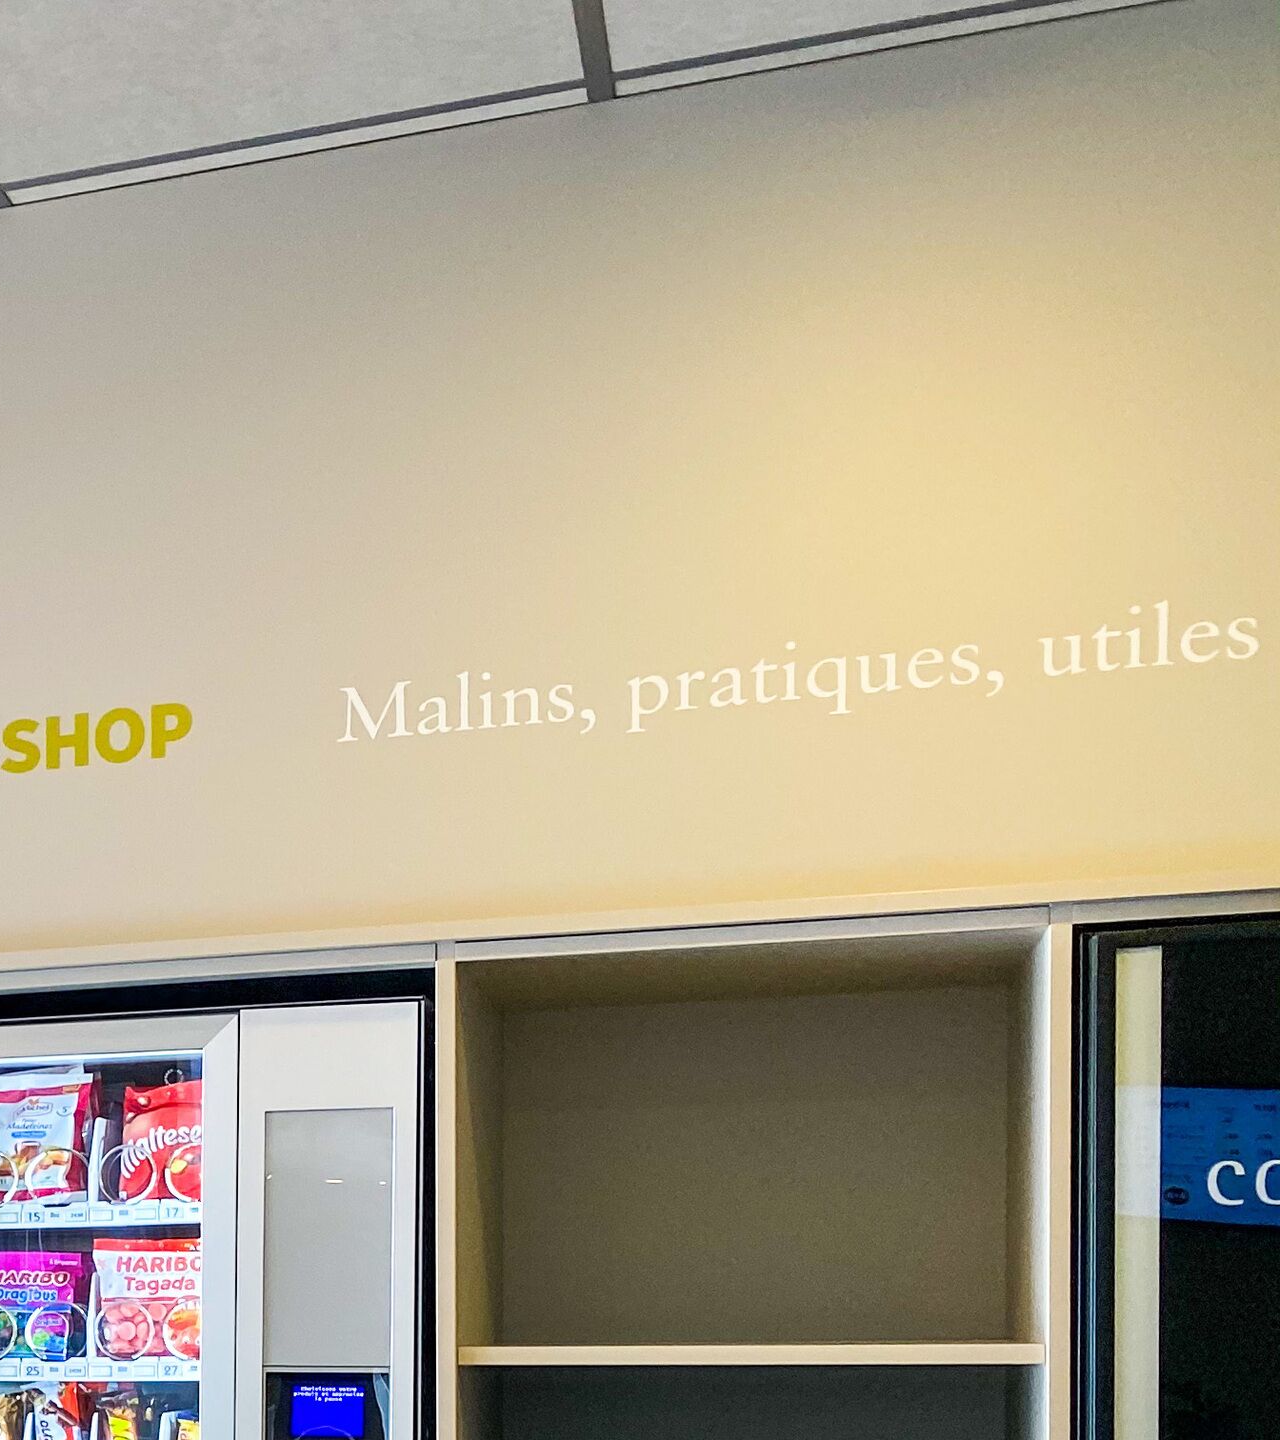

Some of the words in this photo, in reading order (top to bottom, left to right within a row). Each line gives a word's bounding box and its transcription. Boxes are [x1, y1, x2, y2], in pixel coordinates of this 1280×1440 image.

[336, 670, 597, 742] Malins,
[625, 639, 1005, 733] pratiques,
[1036, 600, 1261, 679] utiles
[0, 702, 193, 774] SHOP
[27, 1212, 41, 1222] 15
[166, 1208, 179, 1218] 17
[124, 1276, 195, 1295] Tagada
[26, 1366, 40, 1376] 25
[164, 1366, 178, 1375] 27
